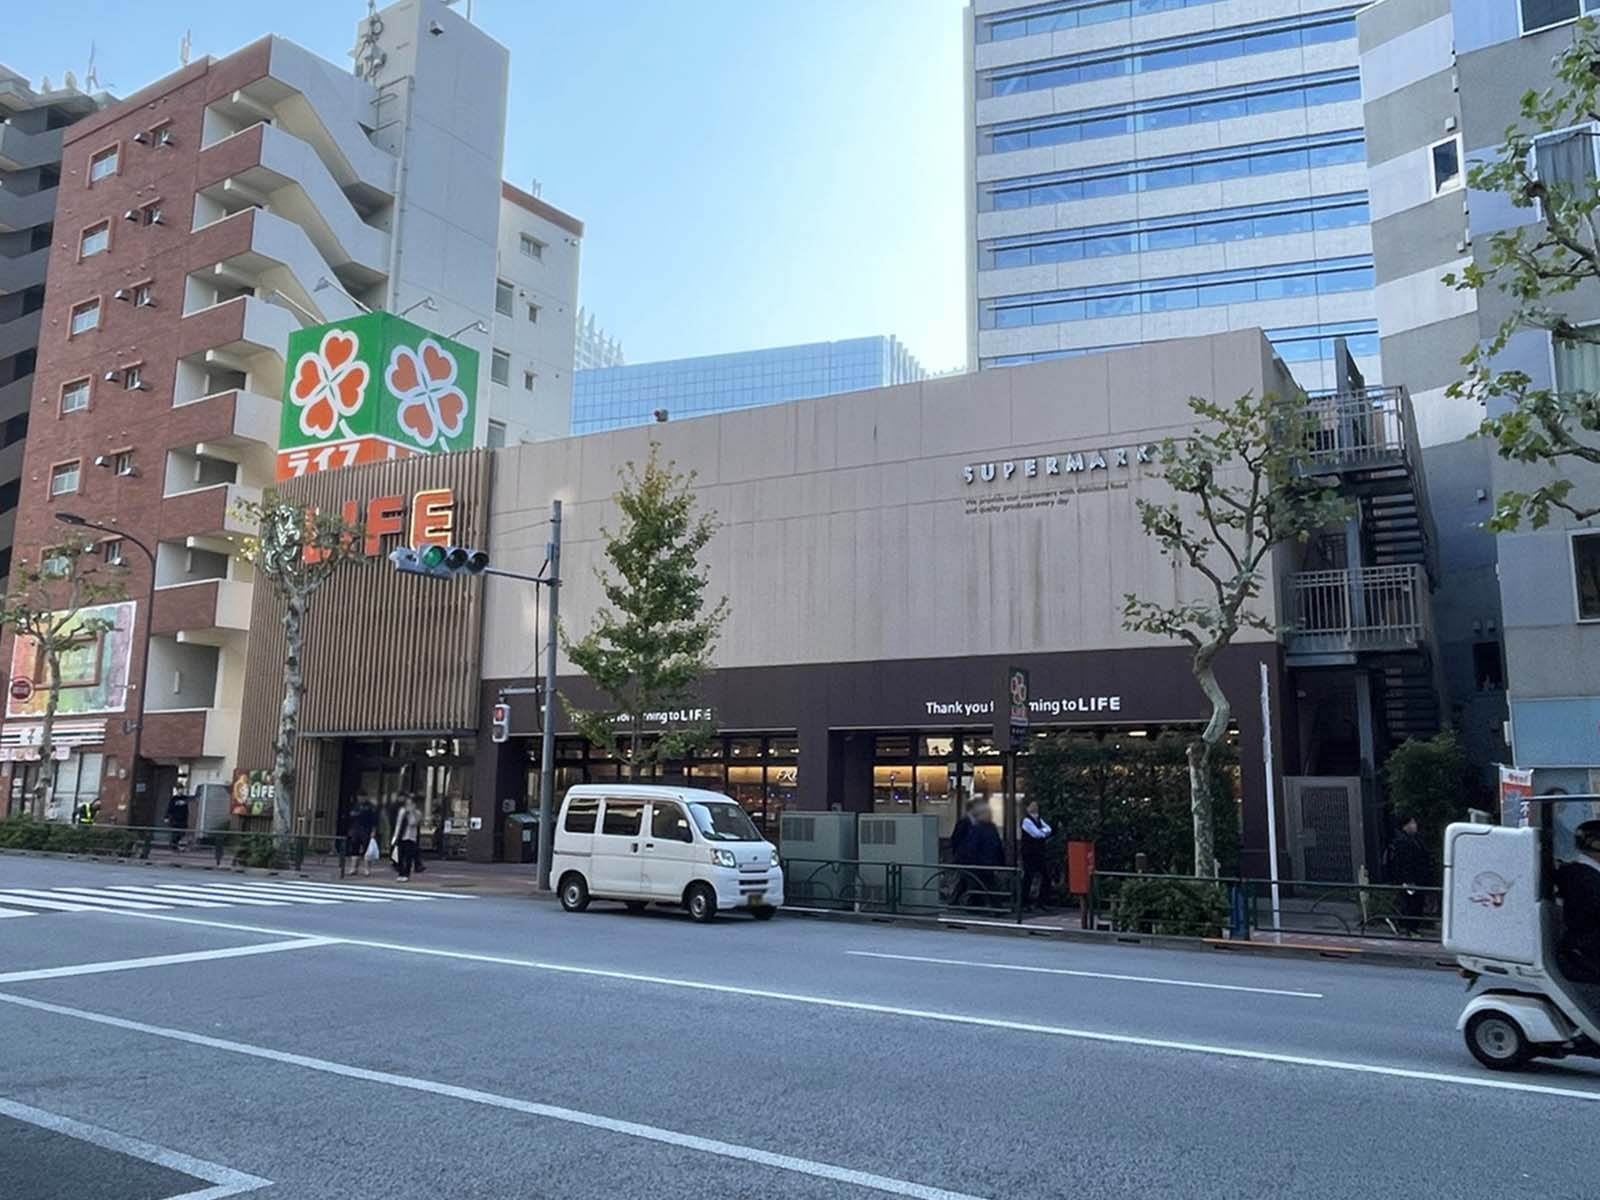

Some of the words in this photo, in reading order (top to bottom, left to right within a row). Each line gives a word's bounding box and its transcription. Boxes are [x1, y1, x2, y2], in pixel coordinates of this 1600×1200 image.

[668, 710, 680, 721] to
[680, 708, 711, 721] LIFE
[926, 700, 964, 714] Thank
[964, 703, 988, 717] you
[1028, 698, 1060, 715] ming
[1061, 698, 1077, 711] to
[1078, 696, 1121, 711] LIFE
